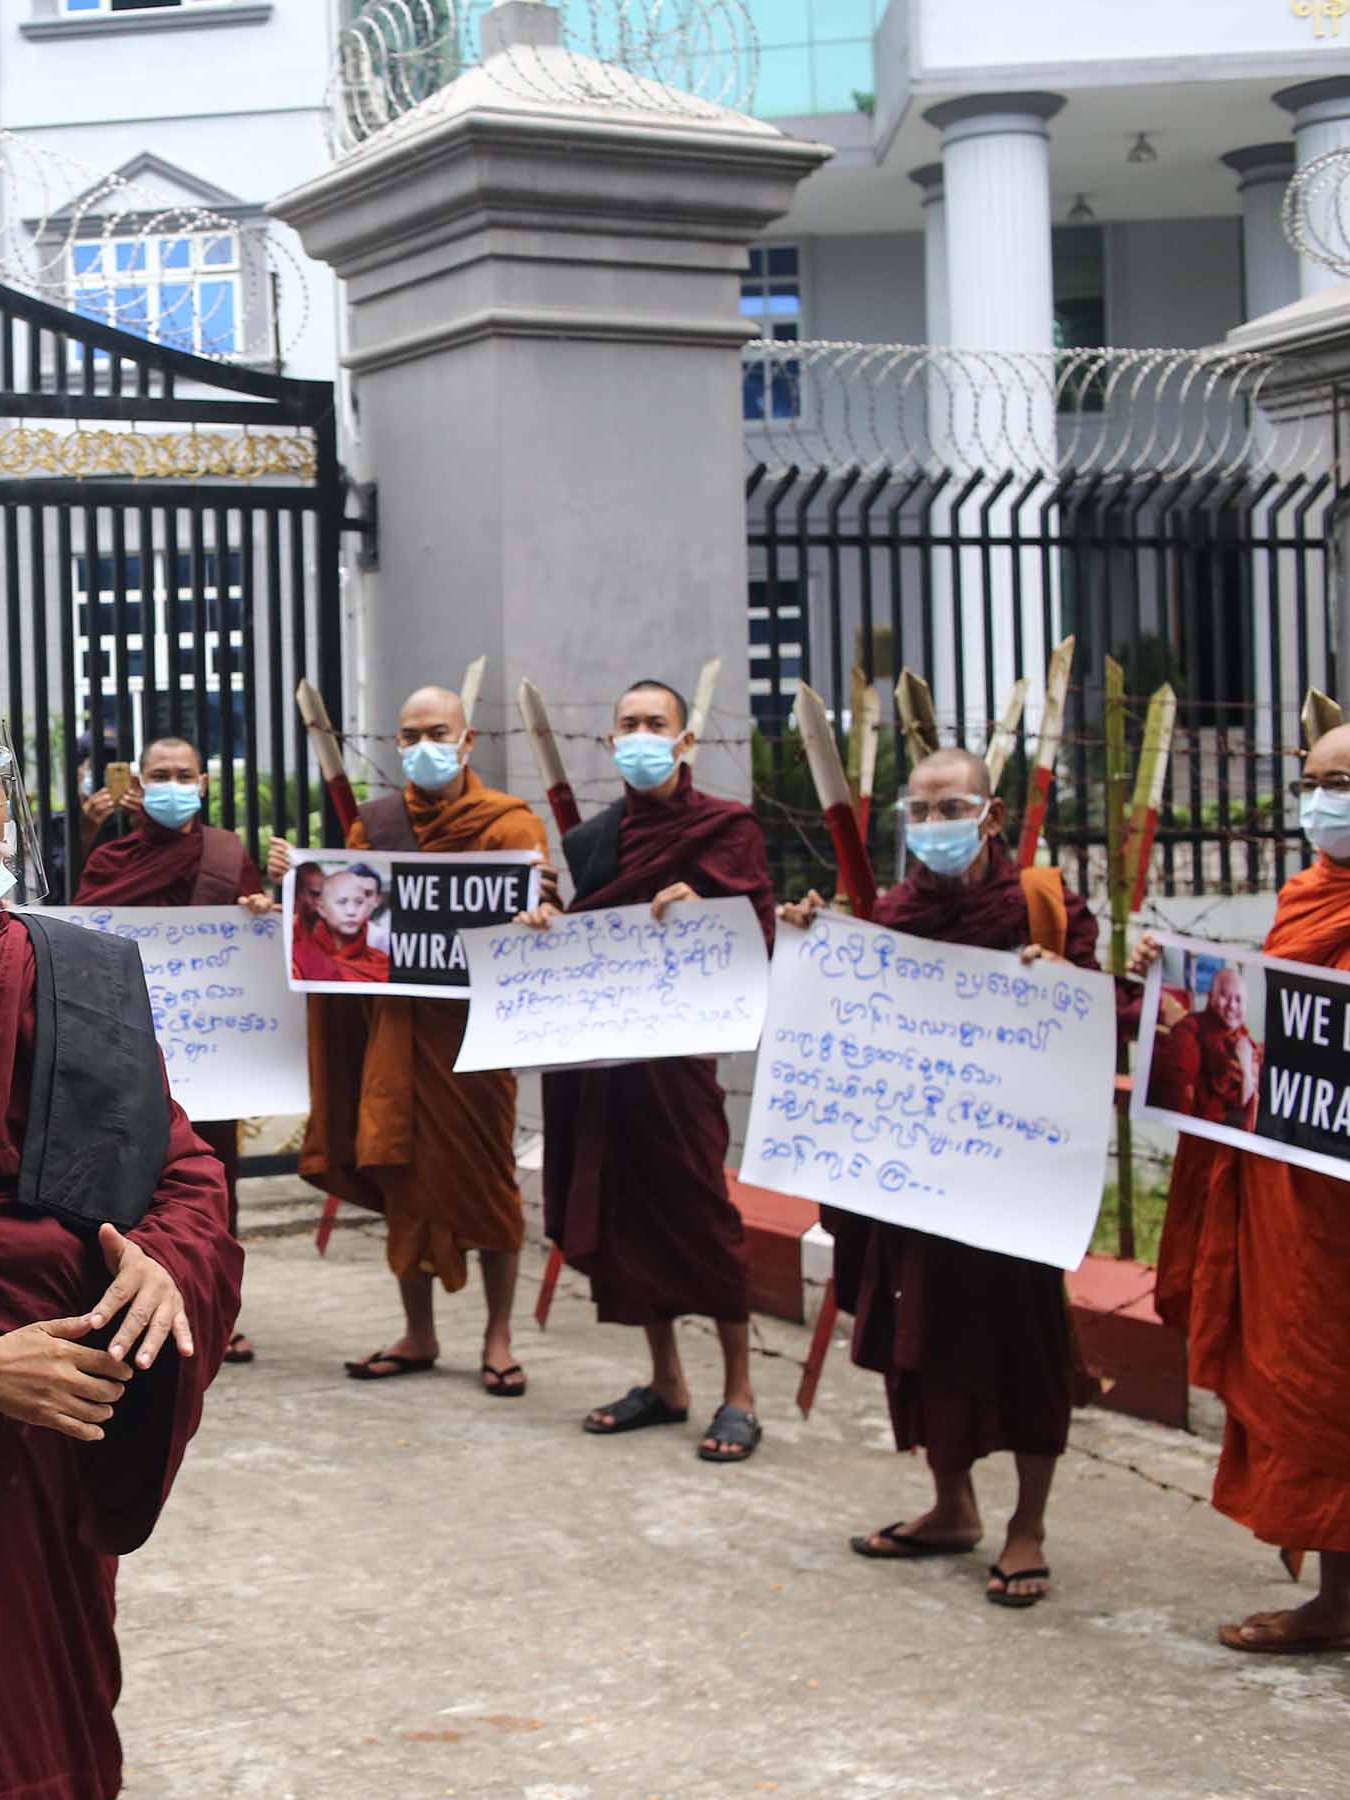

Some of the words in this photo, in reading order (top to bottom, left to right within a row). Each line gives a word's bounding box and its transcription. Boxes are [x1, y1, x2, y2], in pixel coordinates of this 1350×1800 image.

[397, 875, 440, 911] WE
[450, 876, 519, 913] LOVE
[391, 932, 467, 970] WIRA
[1280, 988, 1331, 1046] WE
[1270, 1065, 1350, 1137] WIRA
